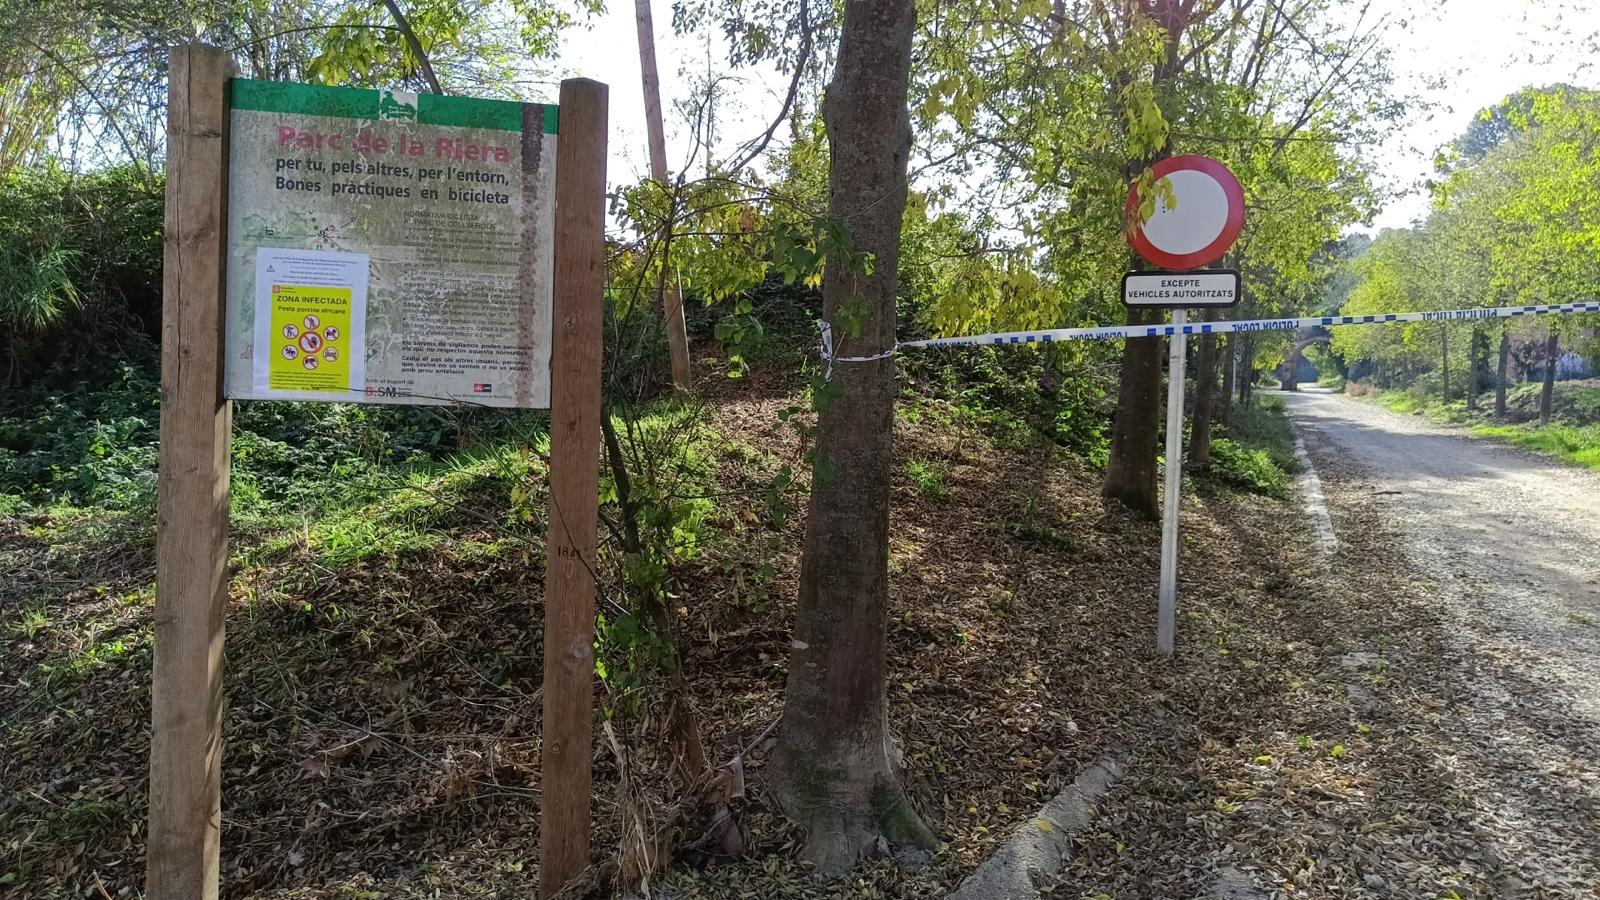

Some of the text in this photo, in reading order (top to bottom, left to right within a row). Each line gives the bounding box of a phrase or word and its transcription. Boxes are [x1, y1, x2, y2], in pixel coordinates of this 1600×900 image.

[278, 125, 510, 162] Parc de la Riera
[276, 158, 302, 171] per
[307, 158, 326, 173] tu,
[331, 160, 362, 175] pels
[367, 161, 413, 179] altres,
[418, 167, 443, 181] per
[276, 176, 509, 204] Bones pràctiques en bicicleta
[277, 295, 347, 305] ZONA INFECTADA
[1128, 289, 1233, 298] VEHICLES AUTORITZATS
